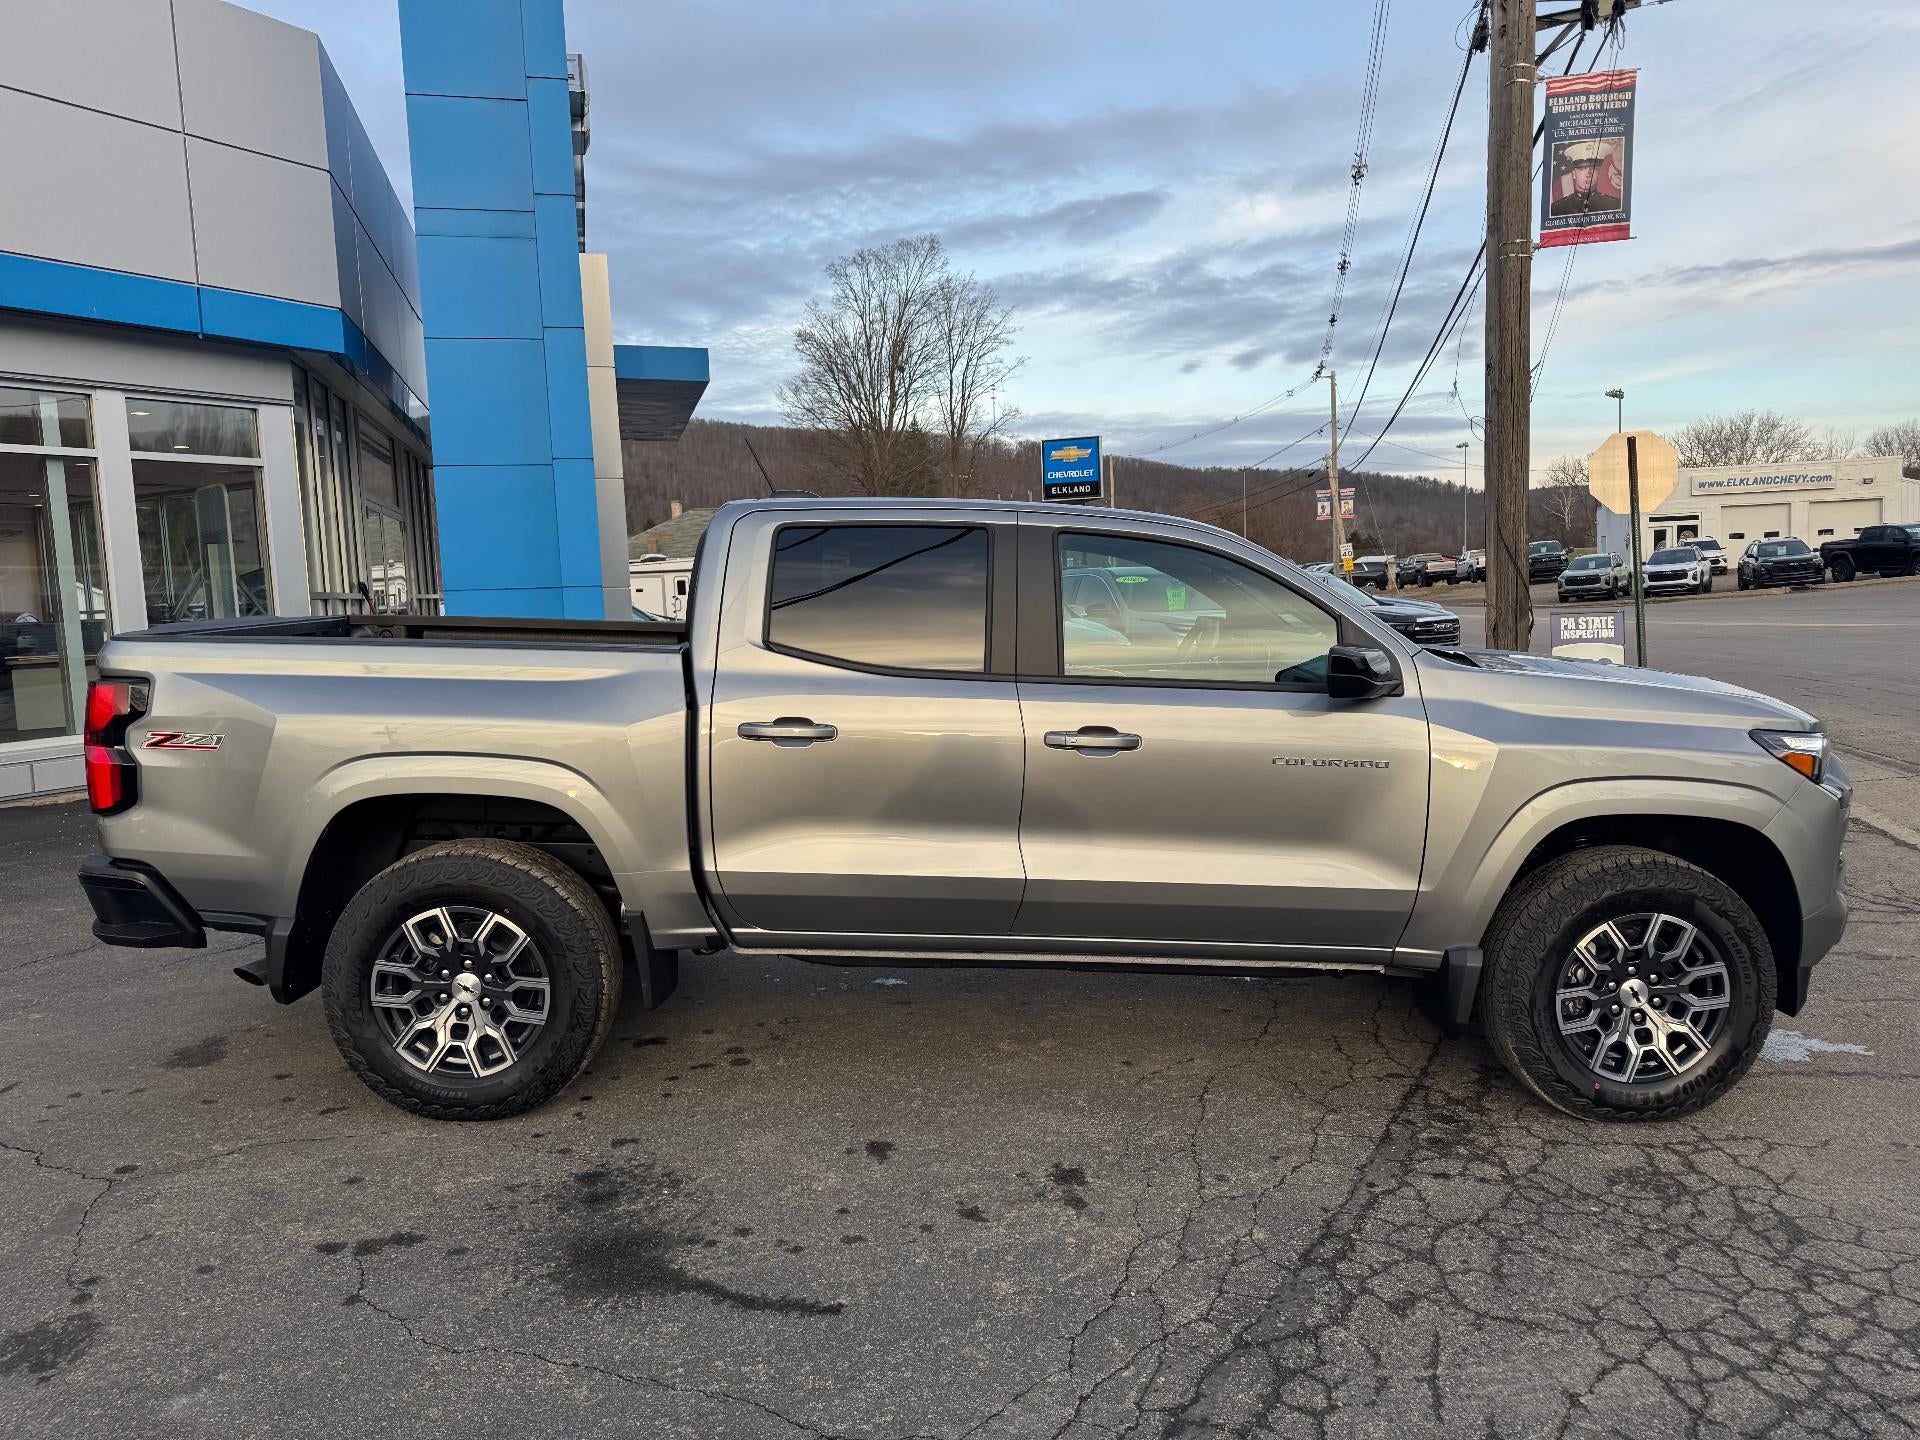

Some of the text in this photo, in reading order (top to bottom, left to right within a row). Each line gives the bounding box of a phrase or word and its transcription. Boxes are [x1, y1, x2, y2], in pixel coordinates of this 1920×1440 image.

[1549, 91, 1632, 106] ELKLAND BOROUGH
[1551, 100, 1628, 114] HOMETOWN HERO
[1559, 117, 1619, 128] MICHAEL PLANK
[1568, 127, 1598, 136] MARINE
[1599, 126, 1624, 134] CORPS
[1047, 468, 1094, 479] CHEVROLET
[1698, 473, 1833, 489] www.ELKLANDCHEVY.com
[1051, 485, 1091, 495] ELKLAND
[1560, 615, 1615, 630] PA STATE
[1560, 628, 1615, 640] INSPECTION
[140, 731, 225, 751] Z71
[1272, 757, 1390, 769] COLORADO
